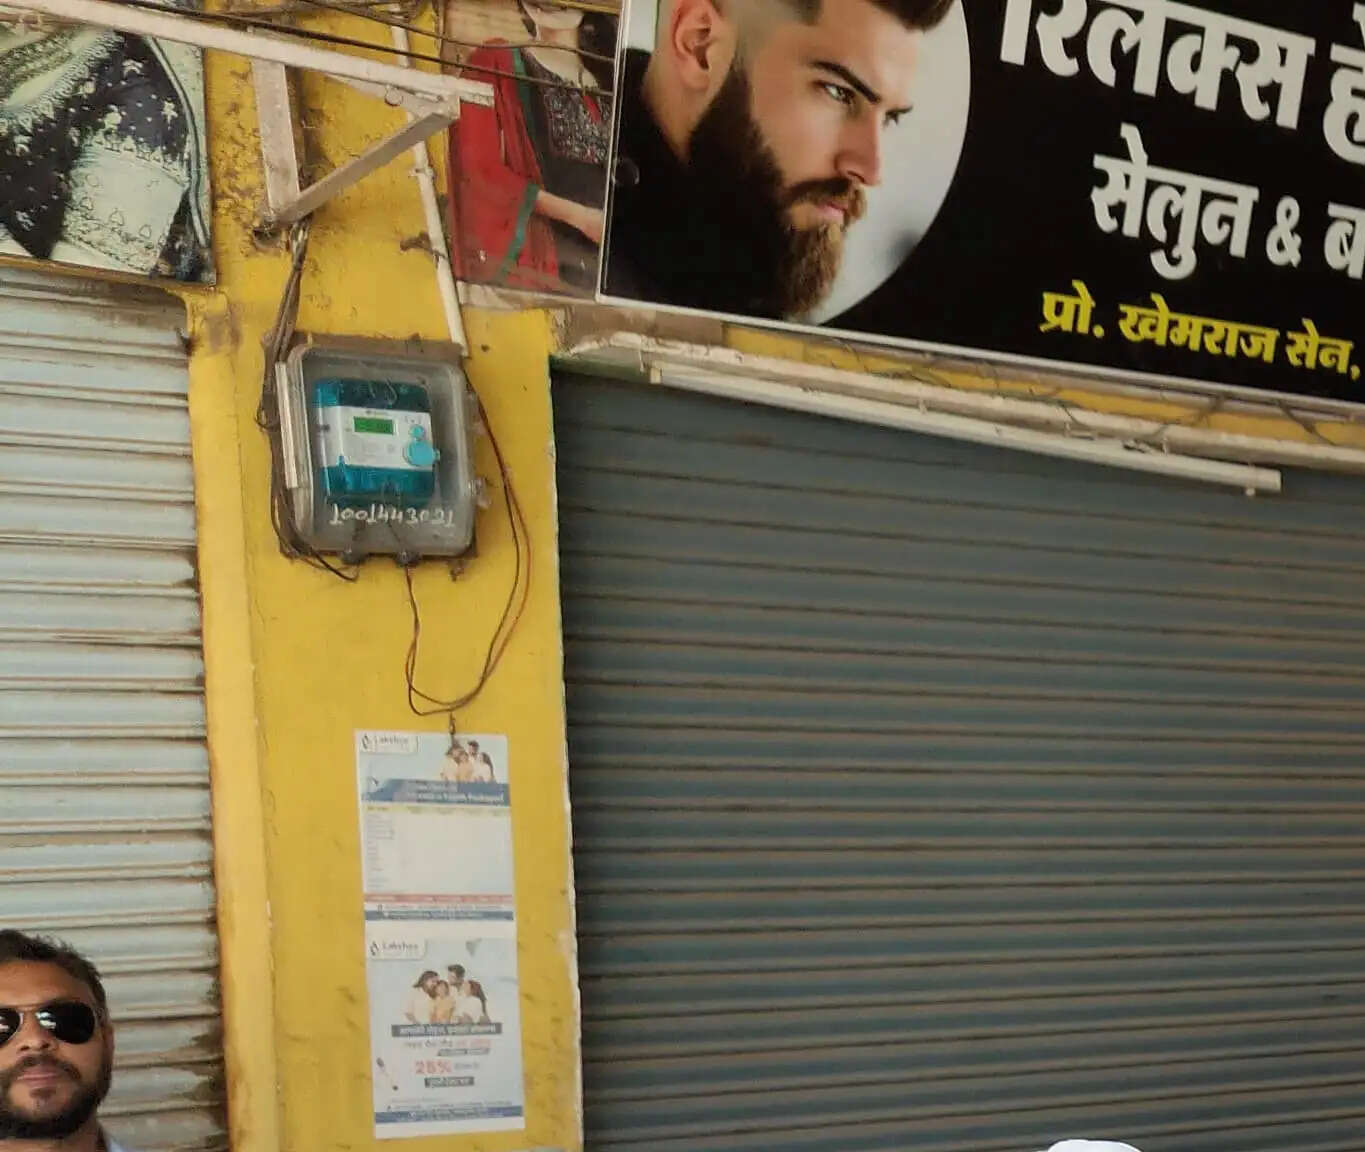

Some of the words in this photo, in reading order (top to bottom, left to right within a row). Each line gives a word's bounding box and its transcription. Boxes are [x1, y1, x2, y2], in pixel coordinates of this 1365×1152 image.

[1091, 122, 1260, 280] सेलुन
[1266, 195, 1302, 268] &
[1040, 279, 1105, 338] प्रो.
[1119, 293, 1280, 364] खेमराज
[1286, 317, 1361, 381] सेन,
